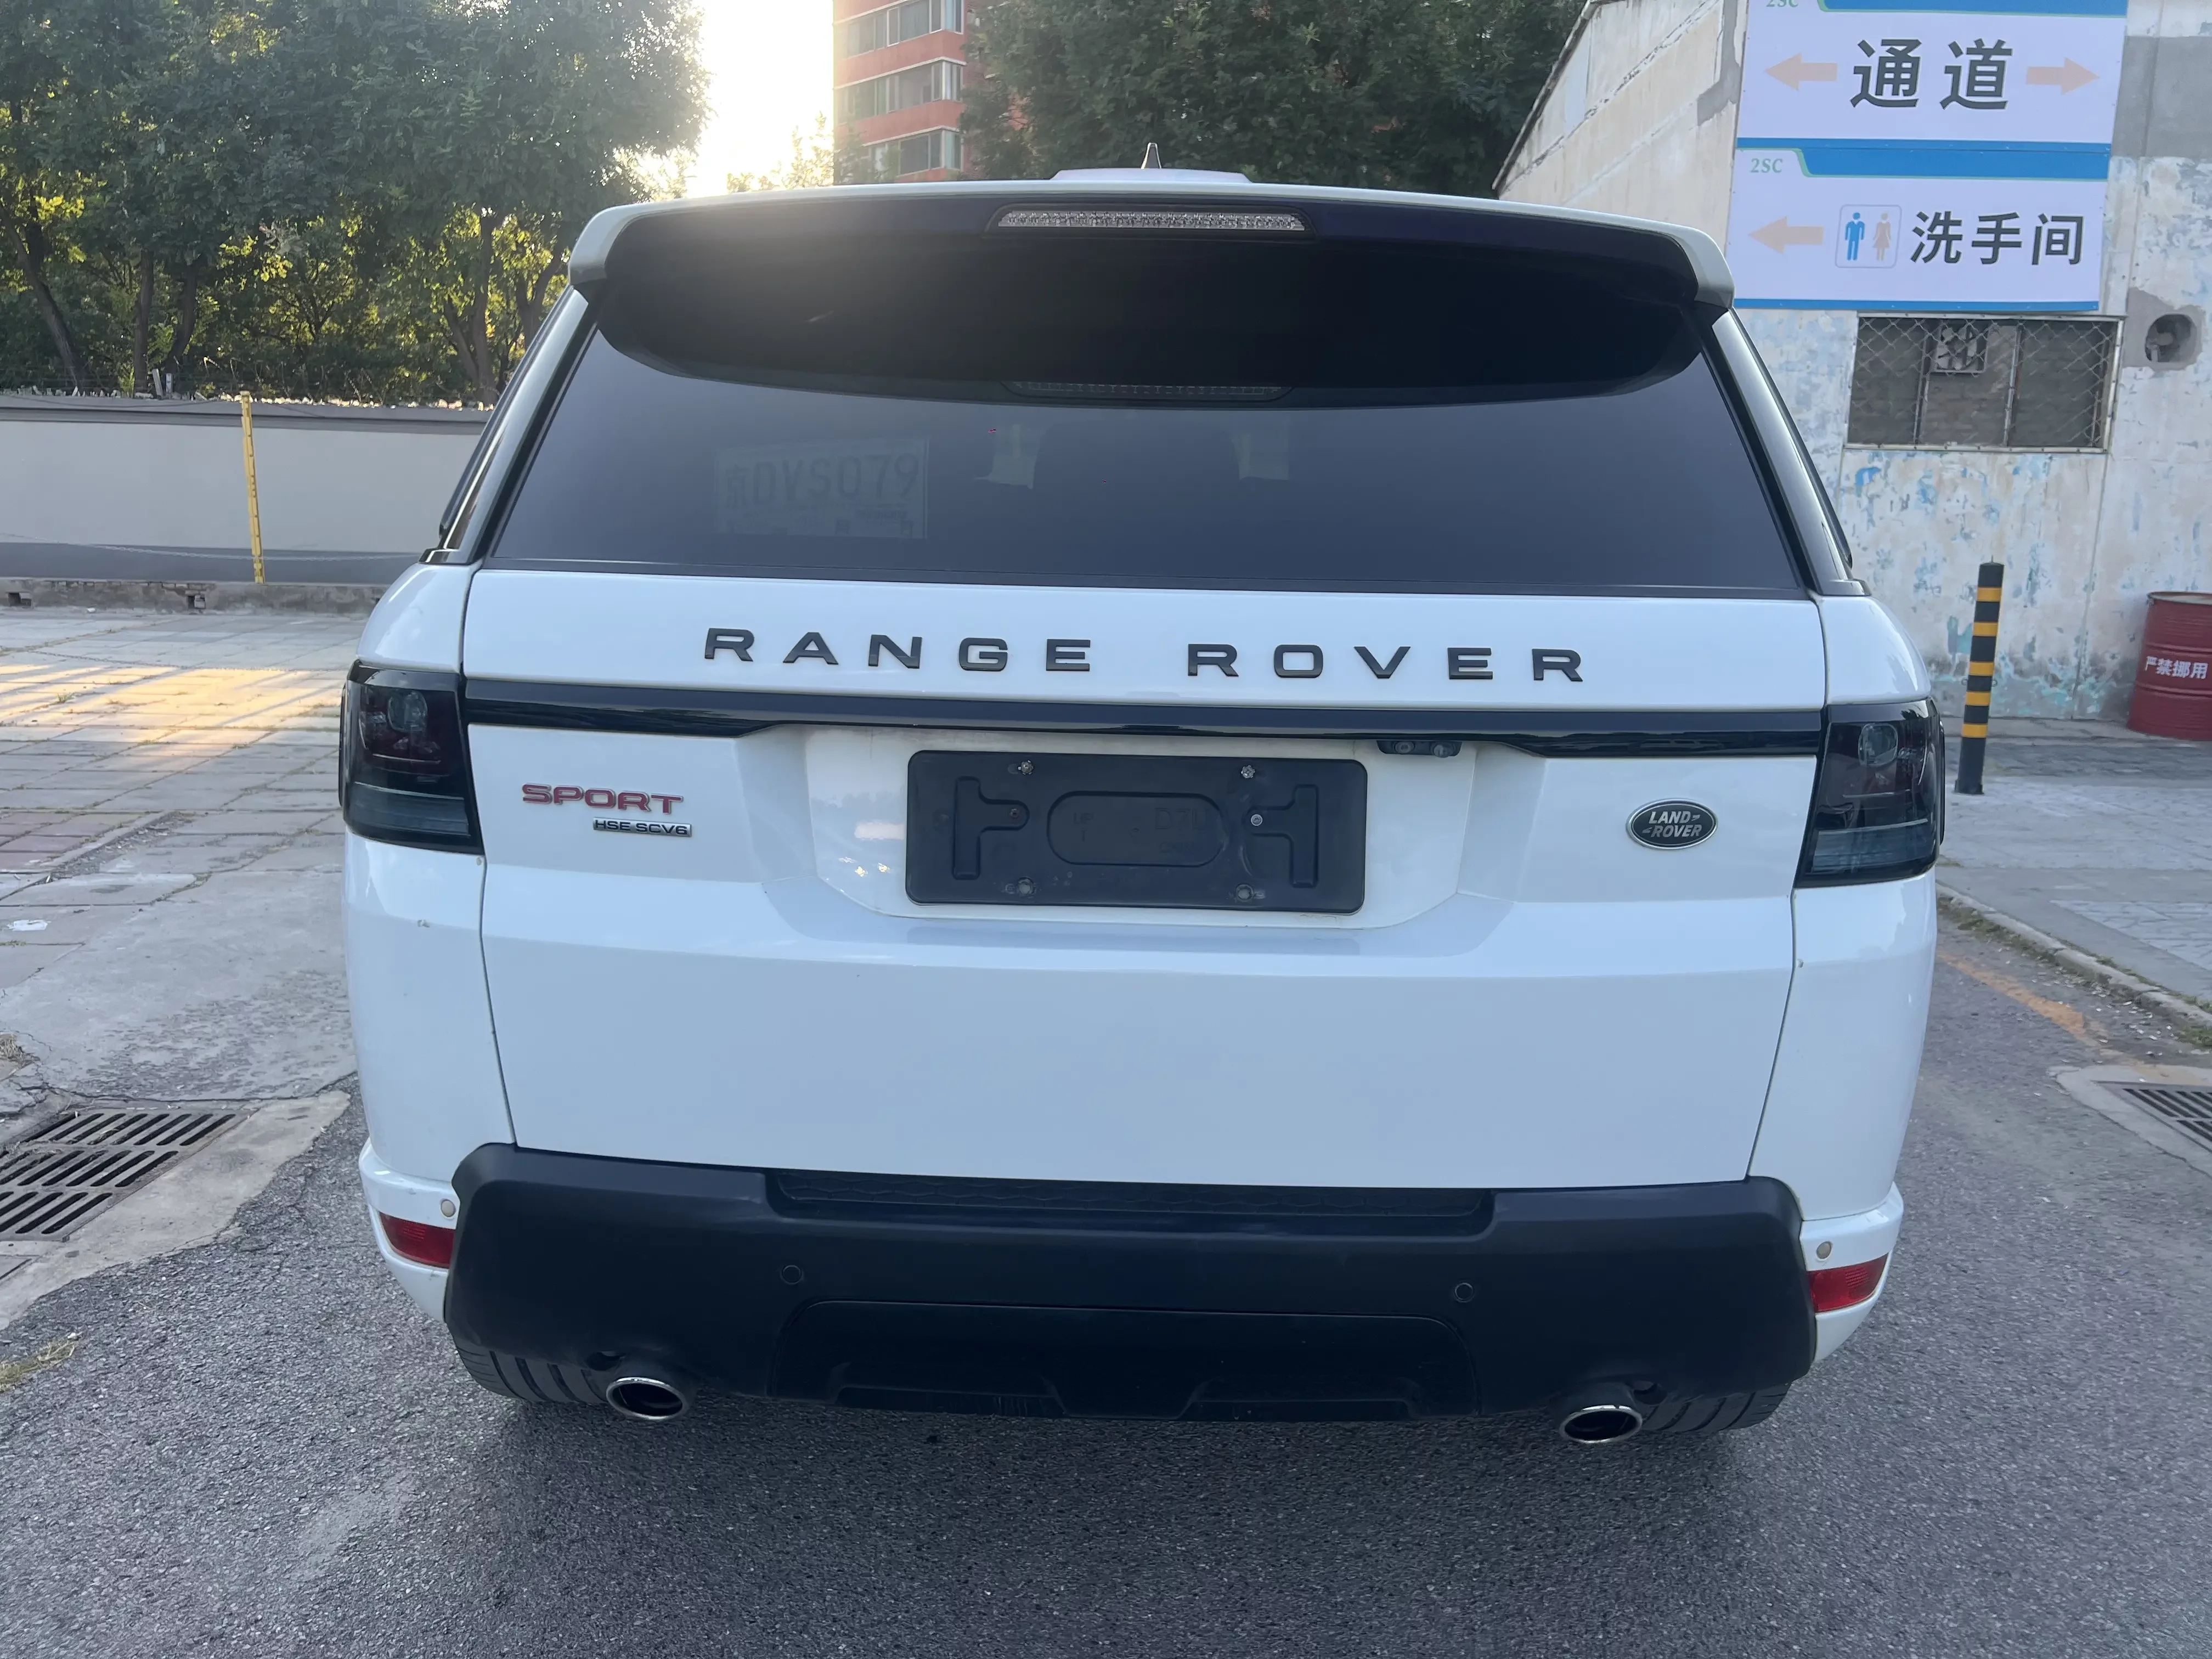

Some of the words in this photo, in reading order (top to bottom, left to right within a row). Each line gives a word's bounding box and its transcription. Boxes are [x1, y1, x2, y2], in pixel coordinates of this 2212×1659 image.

[1850, 39, 2013, 110] 通道
[1750, 158, 1783, 173] 2SC
[1910, 211, 2084, 266] 洗手间
[704, 628, 1091, 672] RANGE
[1188, 644, 1583, 682] ROVER
[2145, 656, 2209, 680] 严禁挪用
[522, 783, 684, 815] SPORT
[595, 820, 631, 832] HSE
[636, 823, 688, 836] SCV6
[1649, 811, 1691, 824] LAND
[1651, 825, 1702, 838] ROVER
